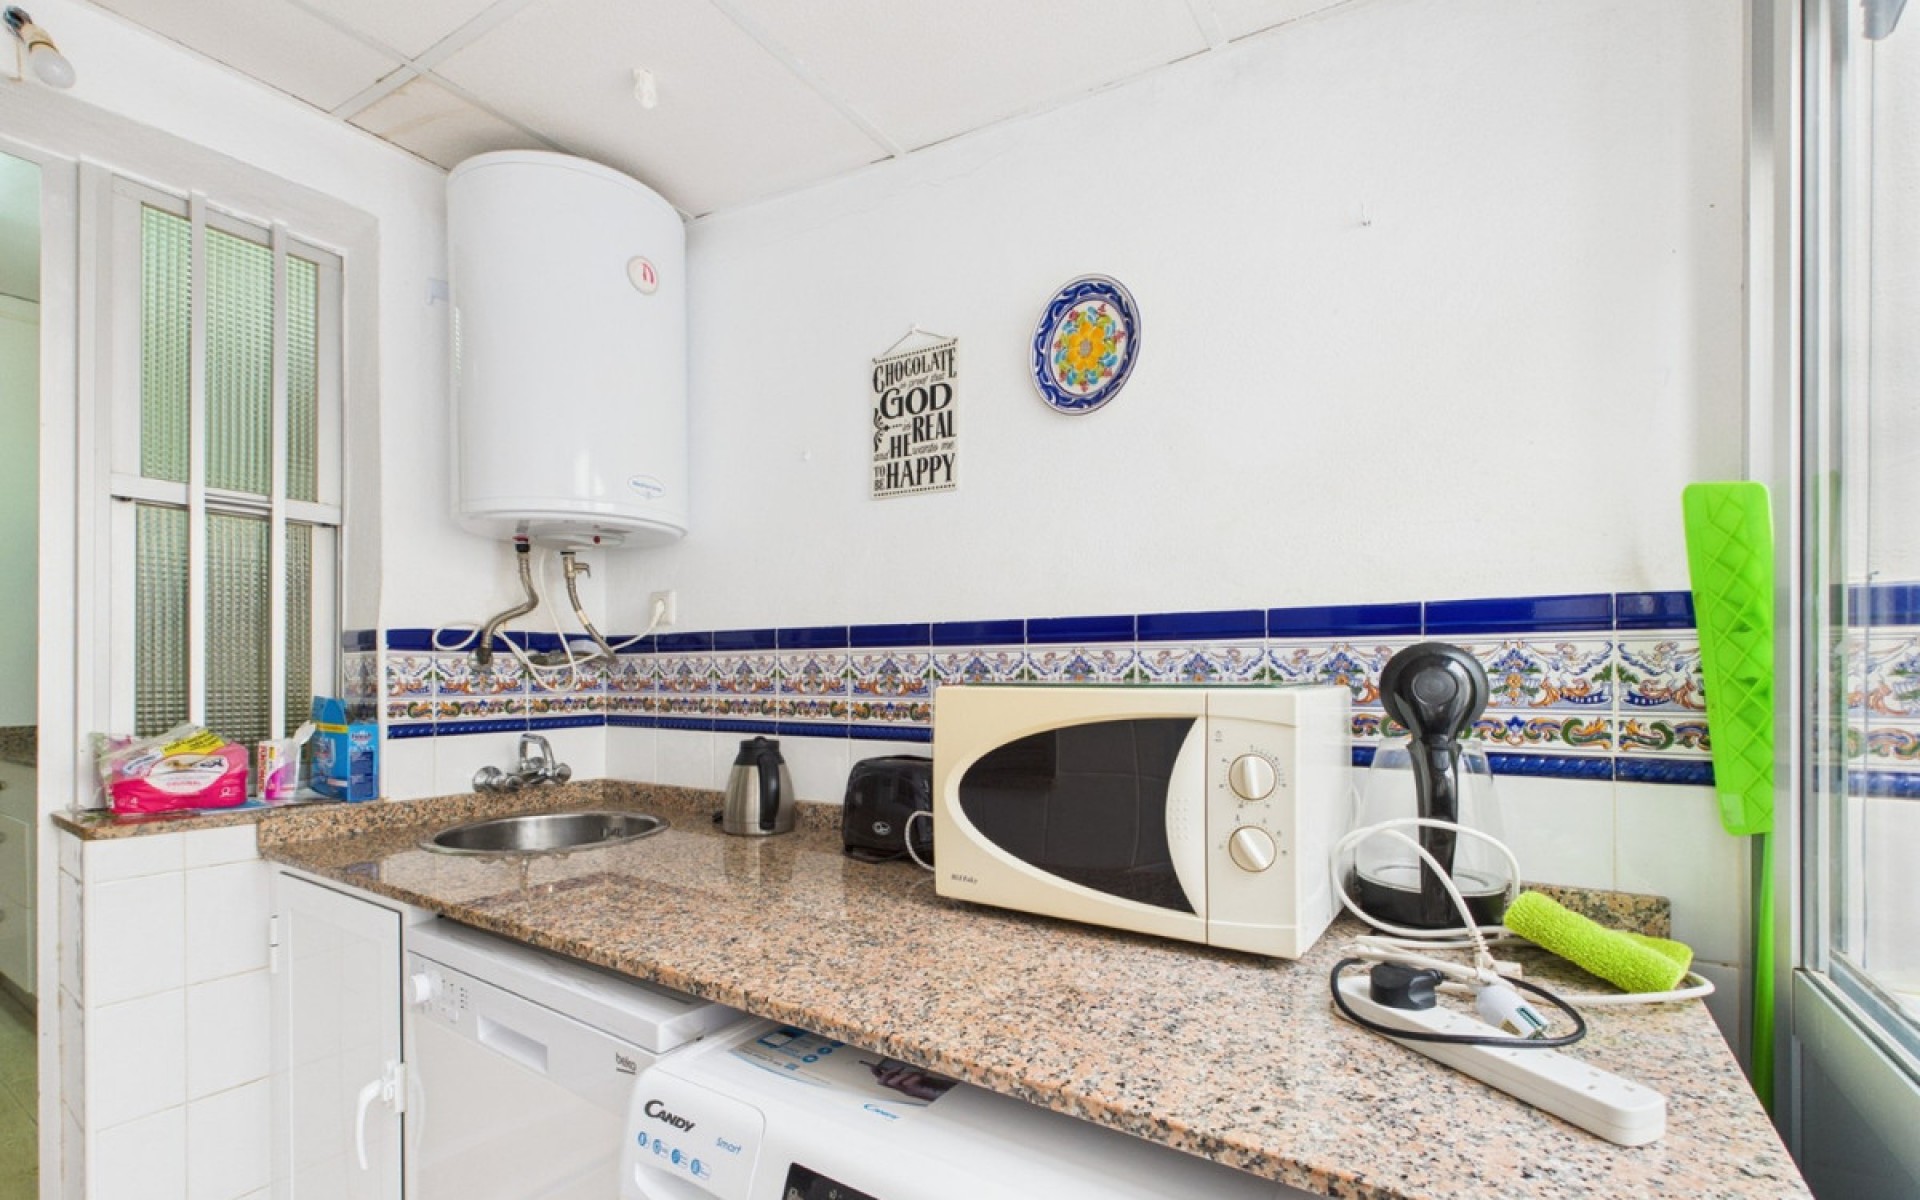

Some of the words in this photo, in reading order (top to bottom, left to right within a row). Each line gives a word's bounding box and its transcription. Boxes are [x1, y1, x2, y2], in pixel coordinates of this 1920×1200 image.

[873, 347, 957, 394] CHOCOLATE
[880, 383, 952, 419] GOD
[912, 410, 957, 443] REAL
[890, 432, 912, 459] HE
[874, 466, 885, 478] TO
[874, 479, 885, 491] BE
[887, 453, 956, 489] HAPPY
[615, 1052, 637, 1071] beko
[716, 1137, 741, 1155] Smart
